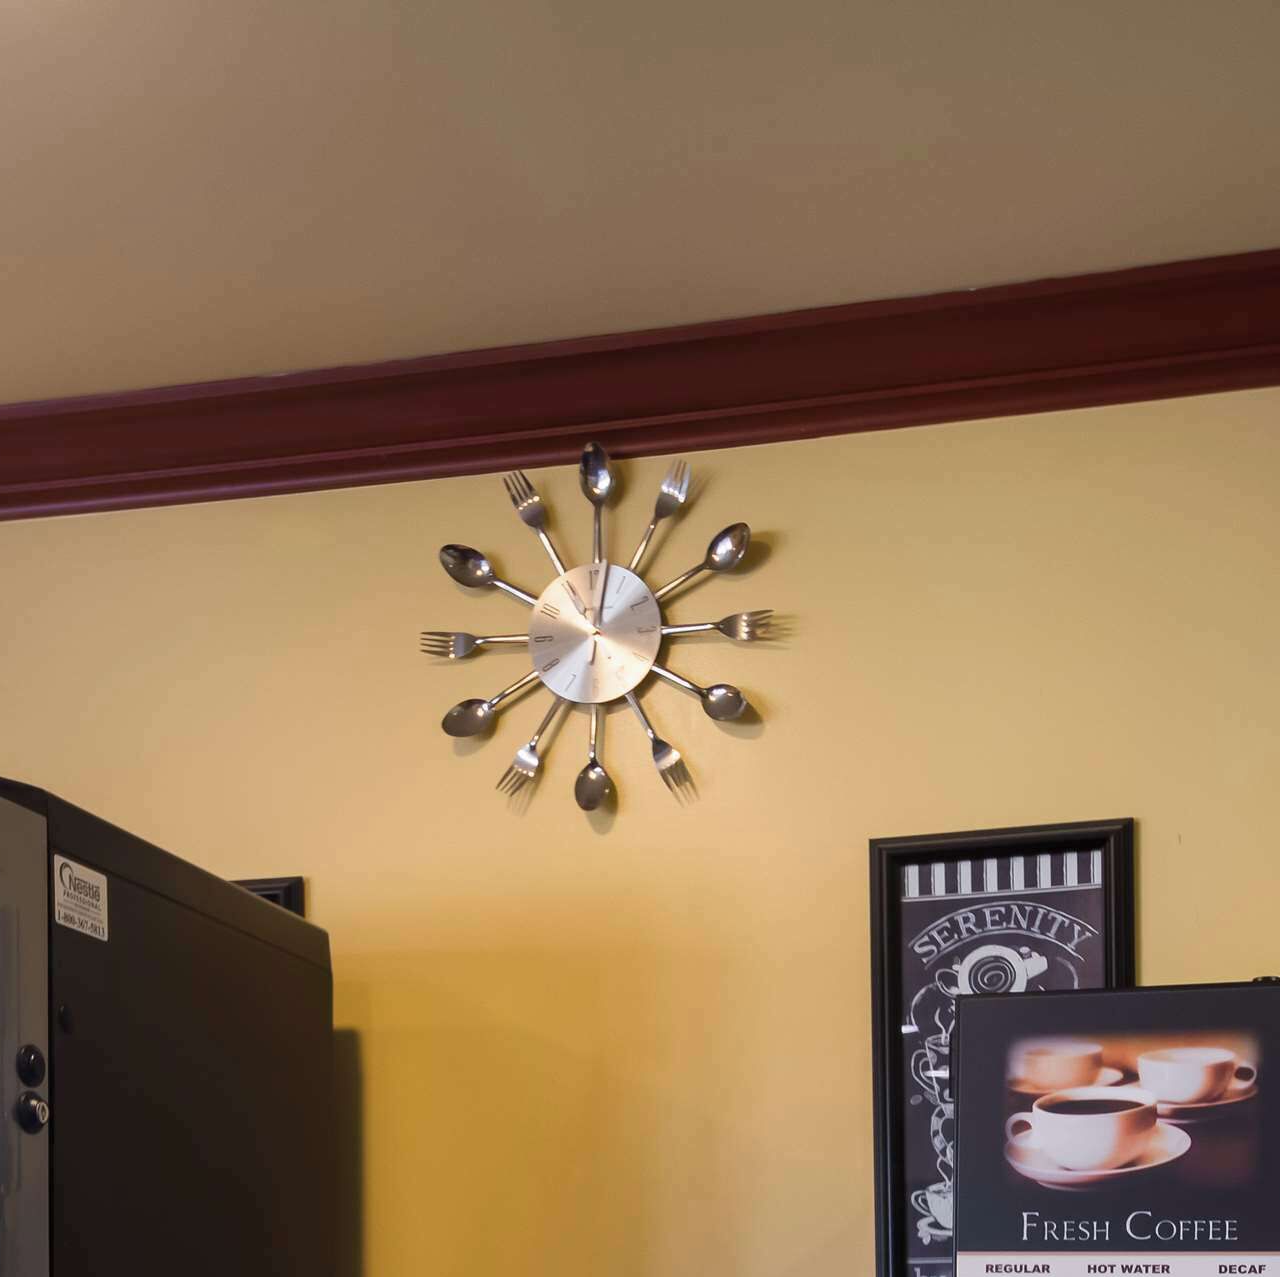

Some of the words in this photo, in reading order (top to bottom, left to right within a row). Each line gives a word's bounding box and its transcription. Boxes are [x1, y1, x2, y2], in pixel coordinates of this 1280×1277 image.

[913, 905, 1092, 964] SERENITY
[985, 1263, 1051, 1275] REGULAR
[1087, 1263, 1117, 1275] HOT
[1121, 1263, 1171, 1275] WATER
[1218, 1264, 1267, 1275] DECAF
